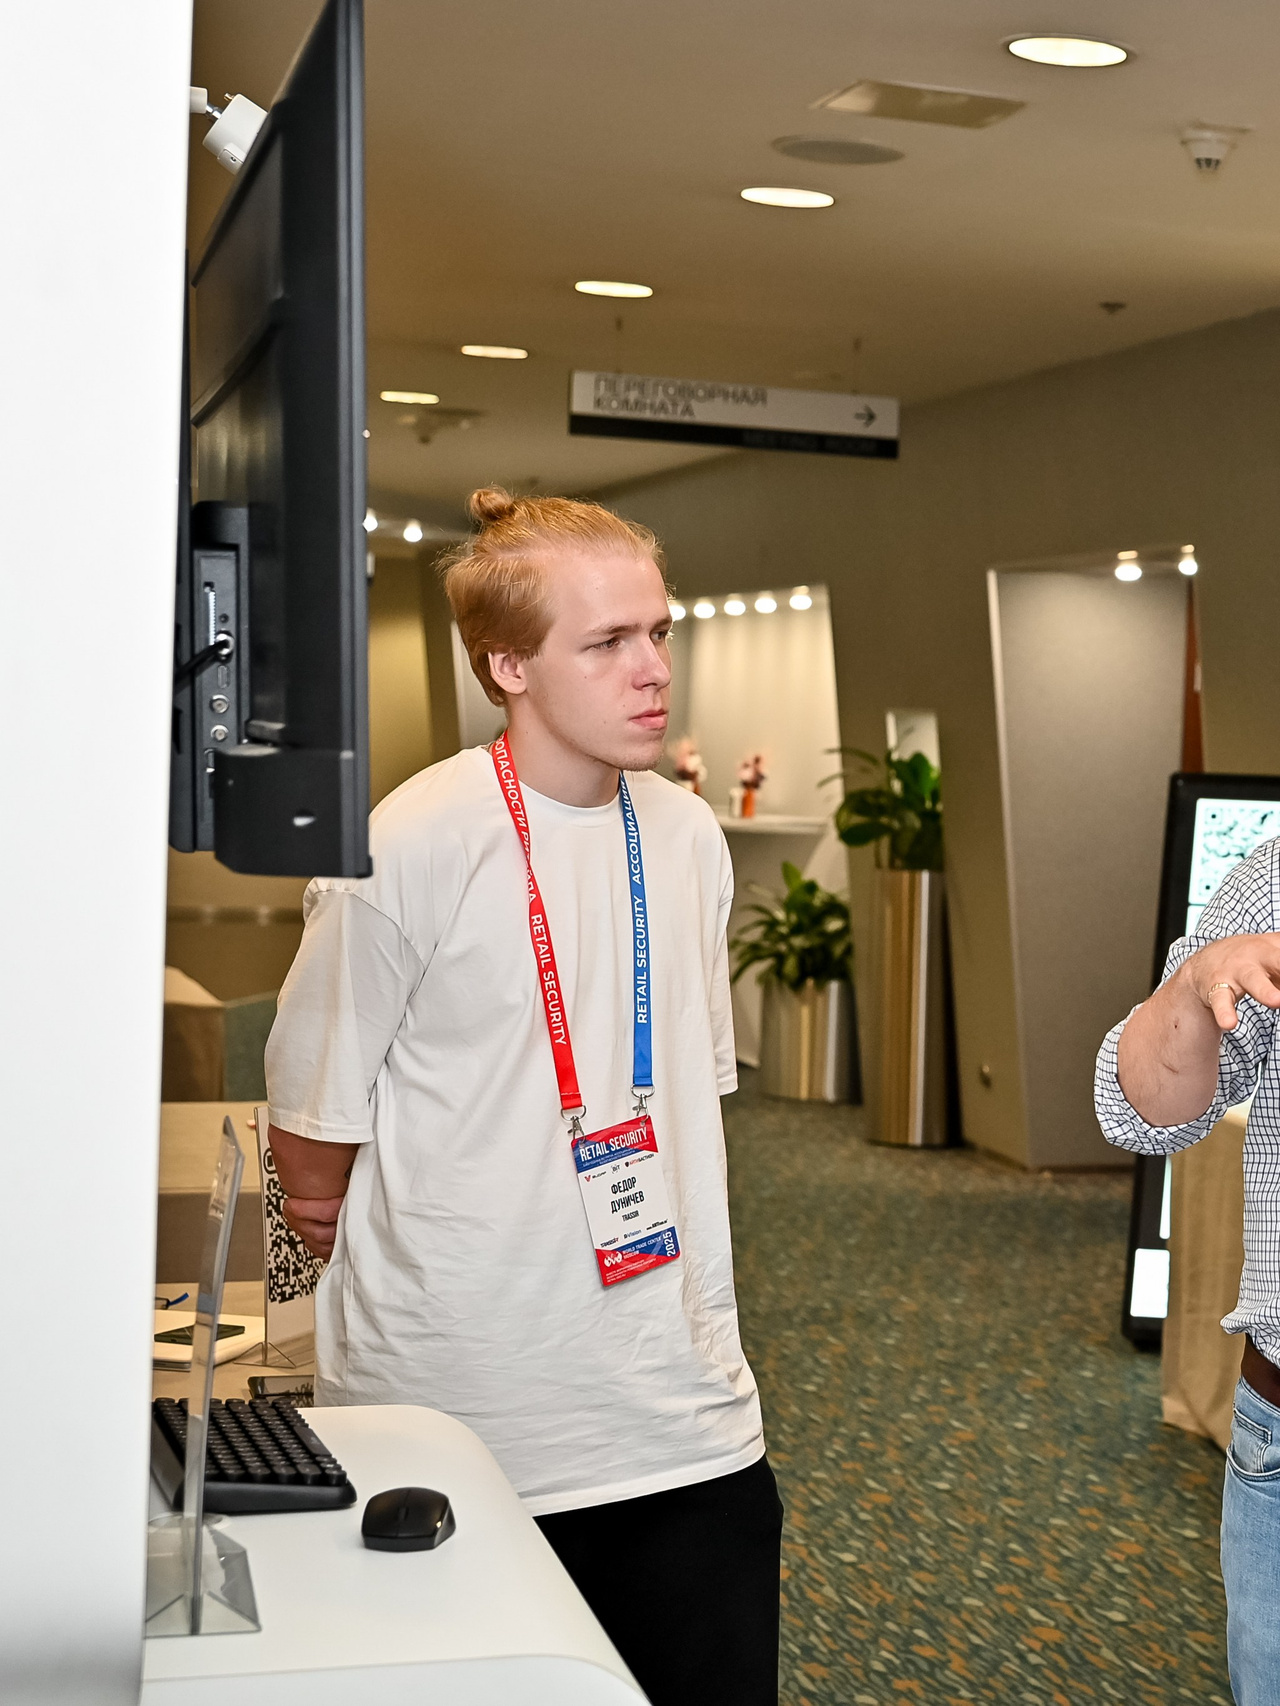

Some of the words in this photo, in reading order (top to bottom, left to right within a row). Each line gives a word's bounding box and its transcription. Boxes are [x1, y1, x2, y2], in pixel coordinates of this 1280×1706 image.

[594, 375, 768, 407] ПЕРЕГОВОРНАЯ
[593, 398, 696, 419] КОМНАТА
[634, 895, 647, 968] SECURITY
[531, 914, 554, 968] RETAIL
[543, 971, 567, 1046] SECURITY
[637, 971, 647, 1024] RETAIL
[580, 1141, 609, 1162] RETAIL
[609, 1127, 648, 1151] SECURITY
[611, 1176, 637, 1195] ФЕДОР
[610, 1191, 645, 1214] ДУНИЧЕВ
[622, 1210, 639, 1222] TRASSIR
[663, 1231, 676, 1257] 2025
